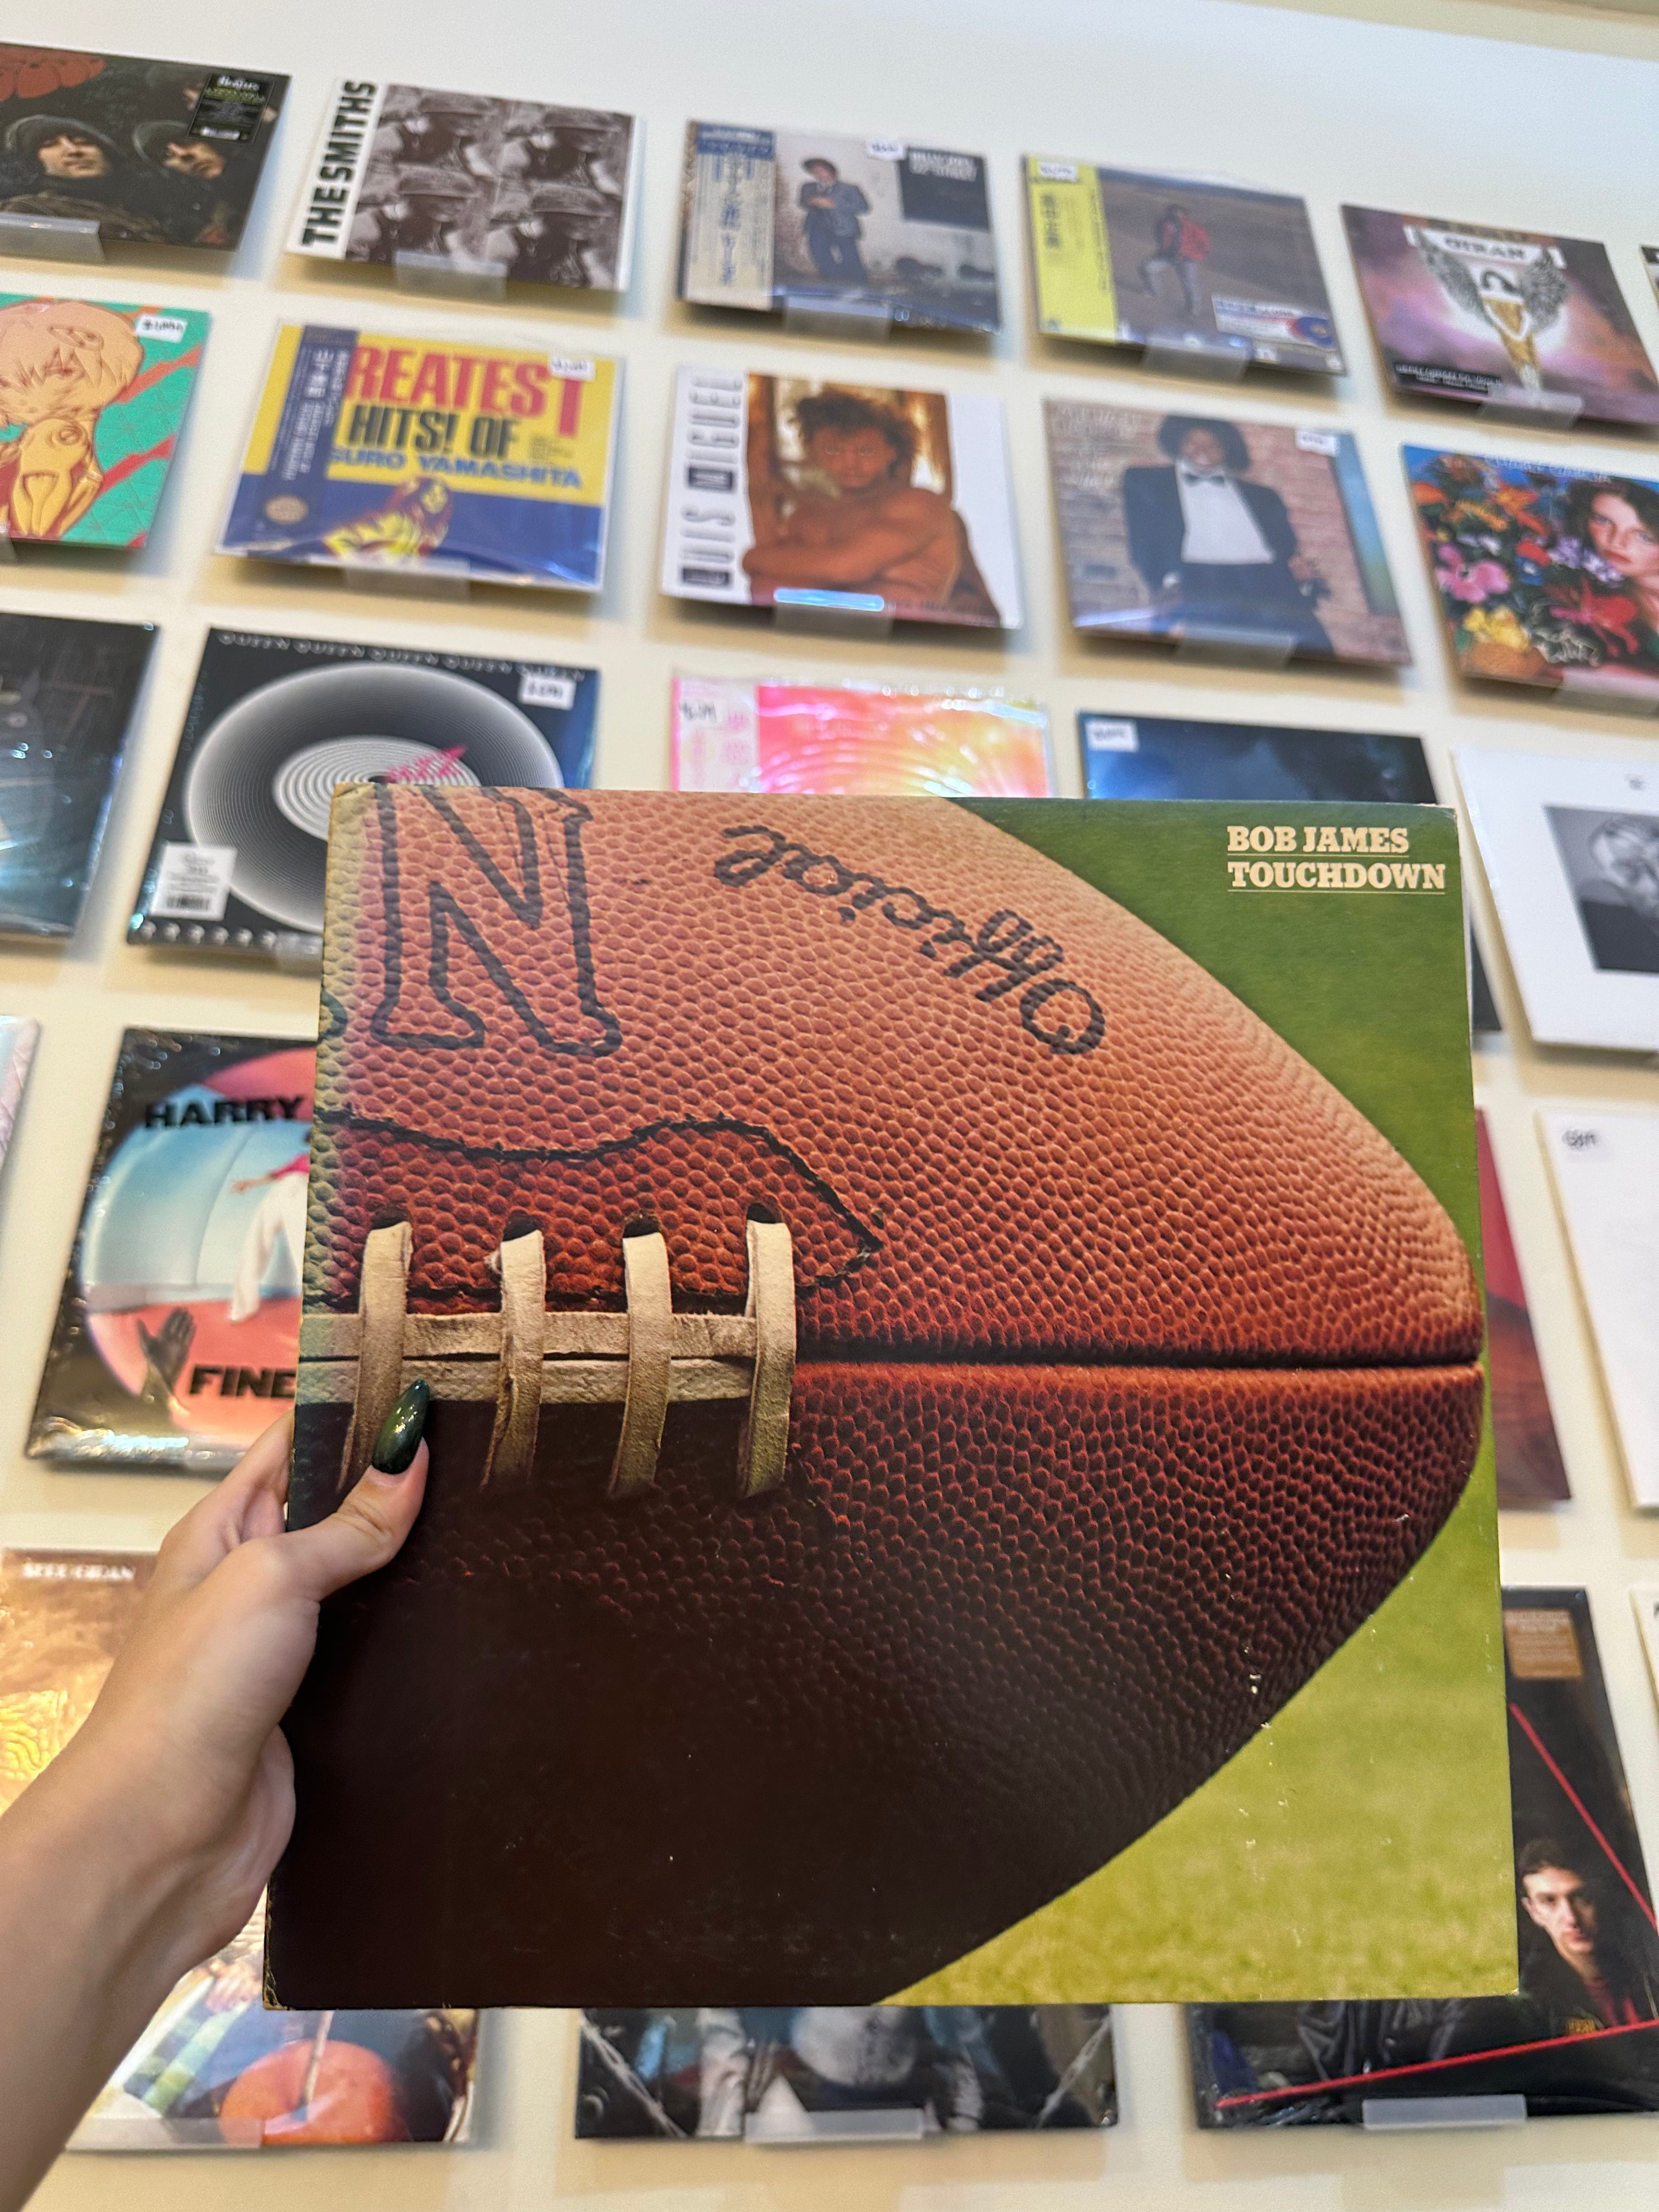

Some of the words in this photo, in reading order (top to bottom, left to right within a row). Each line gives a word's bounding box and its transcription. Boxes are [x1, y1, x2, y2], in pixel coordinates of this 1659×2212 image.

[319, 80, 376, 183] SMITHS
[301, 186, 351, 246] THE
[345, 345, 582, 438] REATEST
[346, 405, 460, 454] HITS!
[470, 415, 521, 459] OF
[329, 449, 405, 470] SURO
[419, 456, 582, 488] YAMASHITA
[1227, 825, 1297, 852] BOB
[1302, 826, 1410, 853] JAMES
[1227, 861, 1446, 890] TOUCHDOWN
[714, 825, 1105, 1055] Official
[145, 1097, 303, 1128] HARRY
[189, 1364, 297, 1398] FINE
